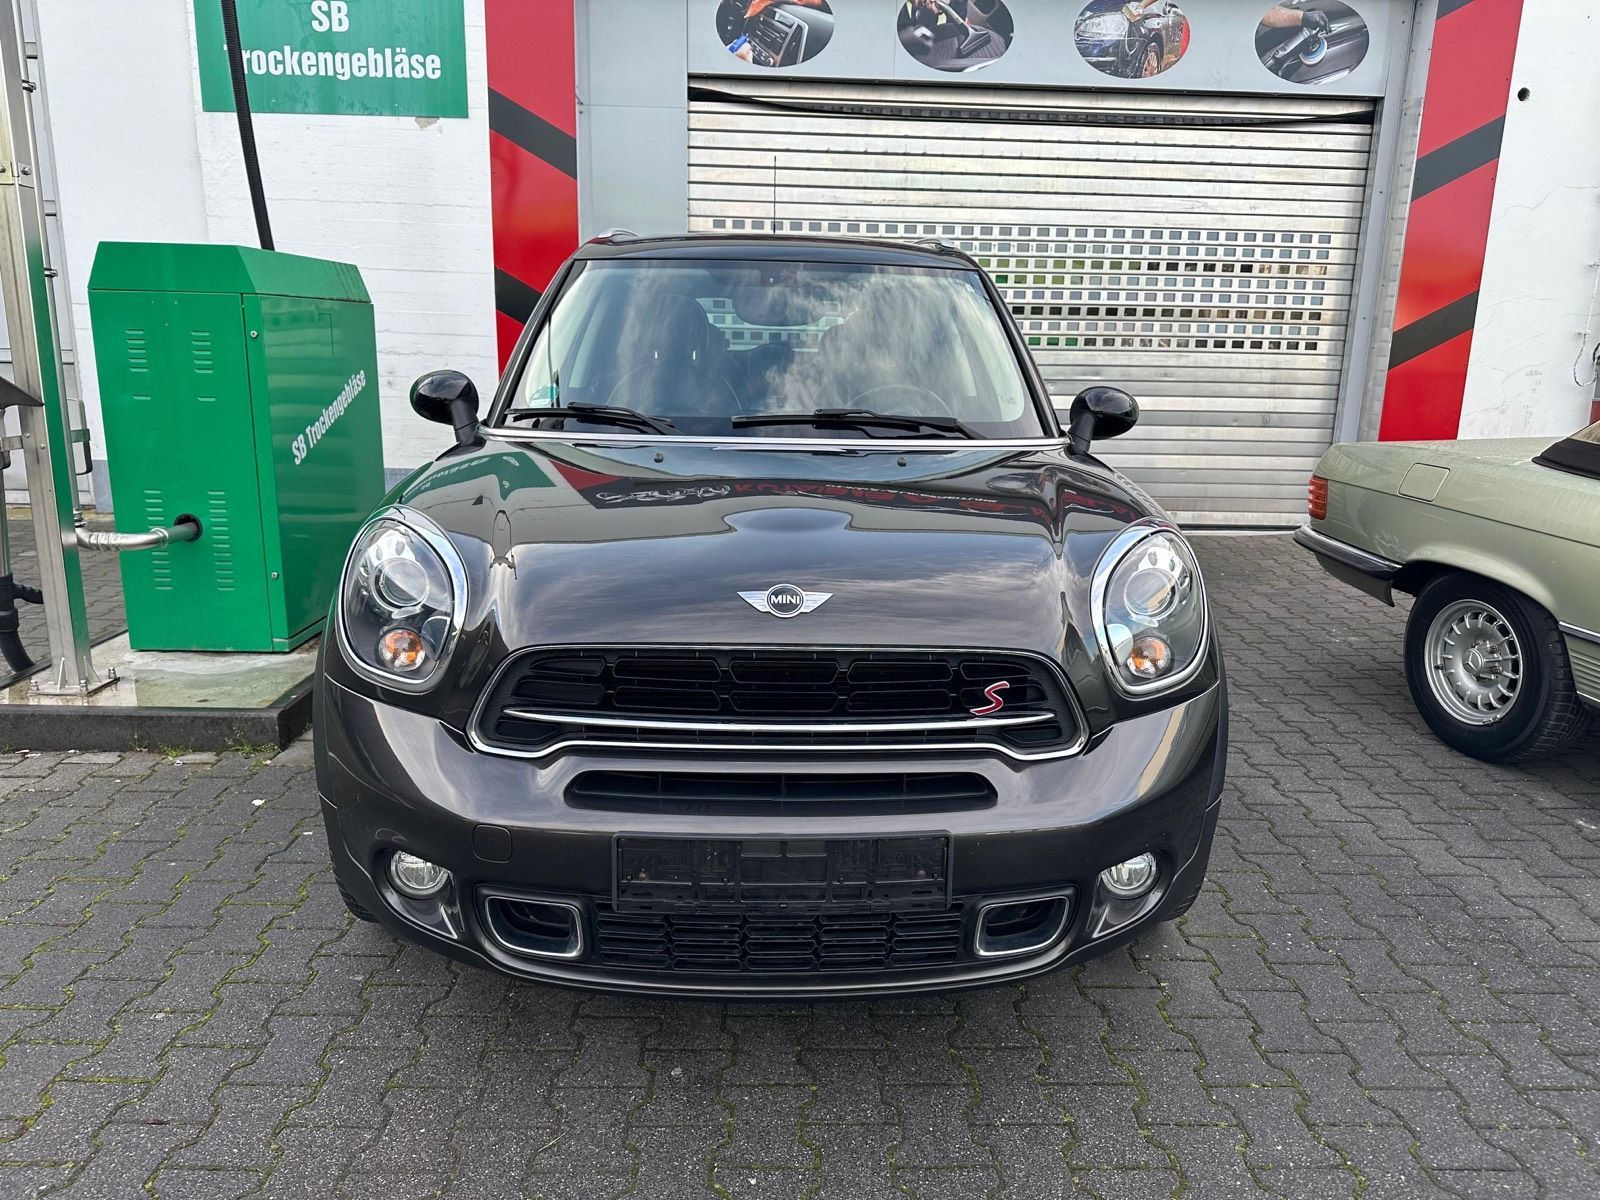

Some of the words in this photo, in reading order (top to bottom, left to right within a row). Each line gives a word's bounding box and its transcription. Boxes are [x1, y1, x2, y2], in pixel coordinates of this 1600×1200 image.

[311, 0, 349, 32] SB
[223, 44, 441, 81] rockengebläse
[292, 434, 307, 465] SB
[305, 369, 366, 448] Trockengebläse
[770, 595, 800, 604] MINI
[969, 680, 1010, 716] S
